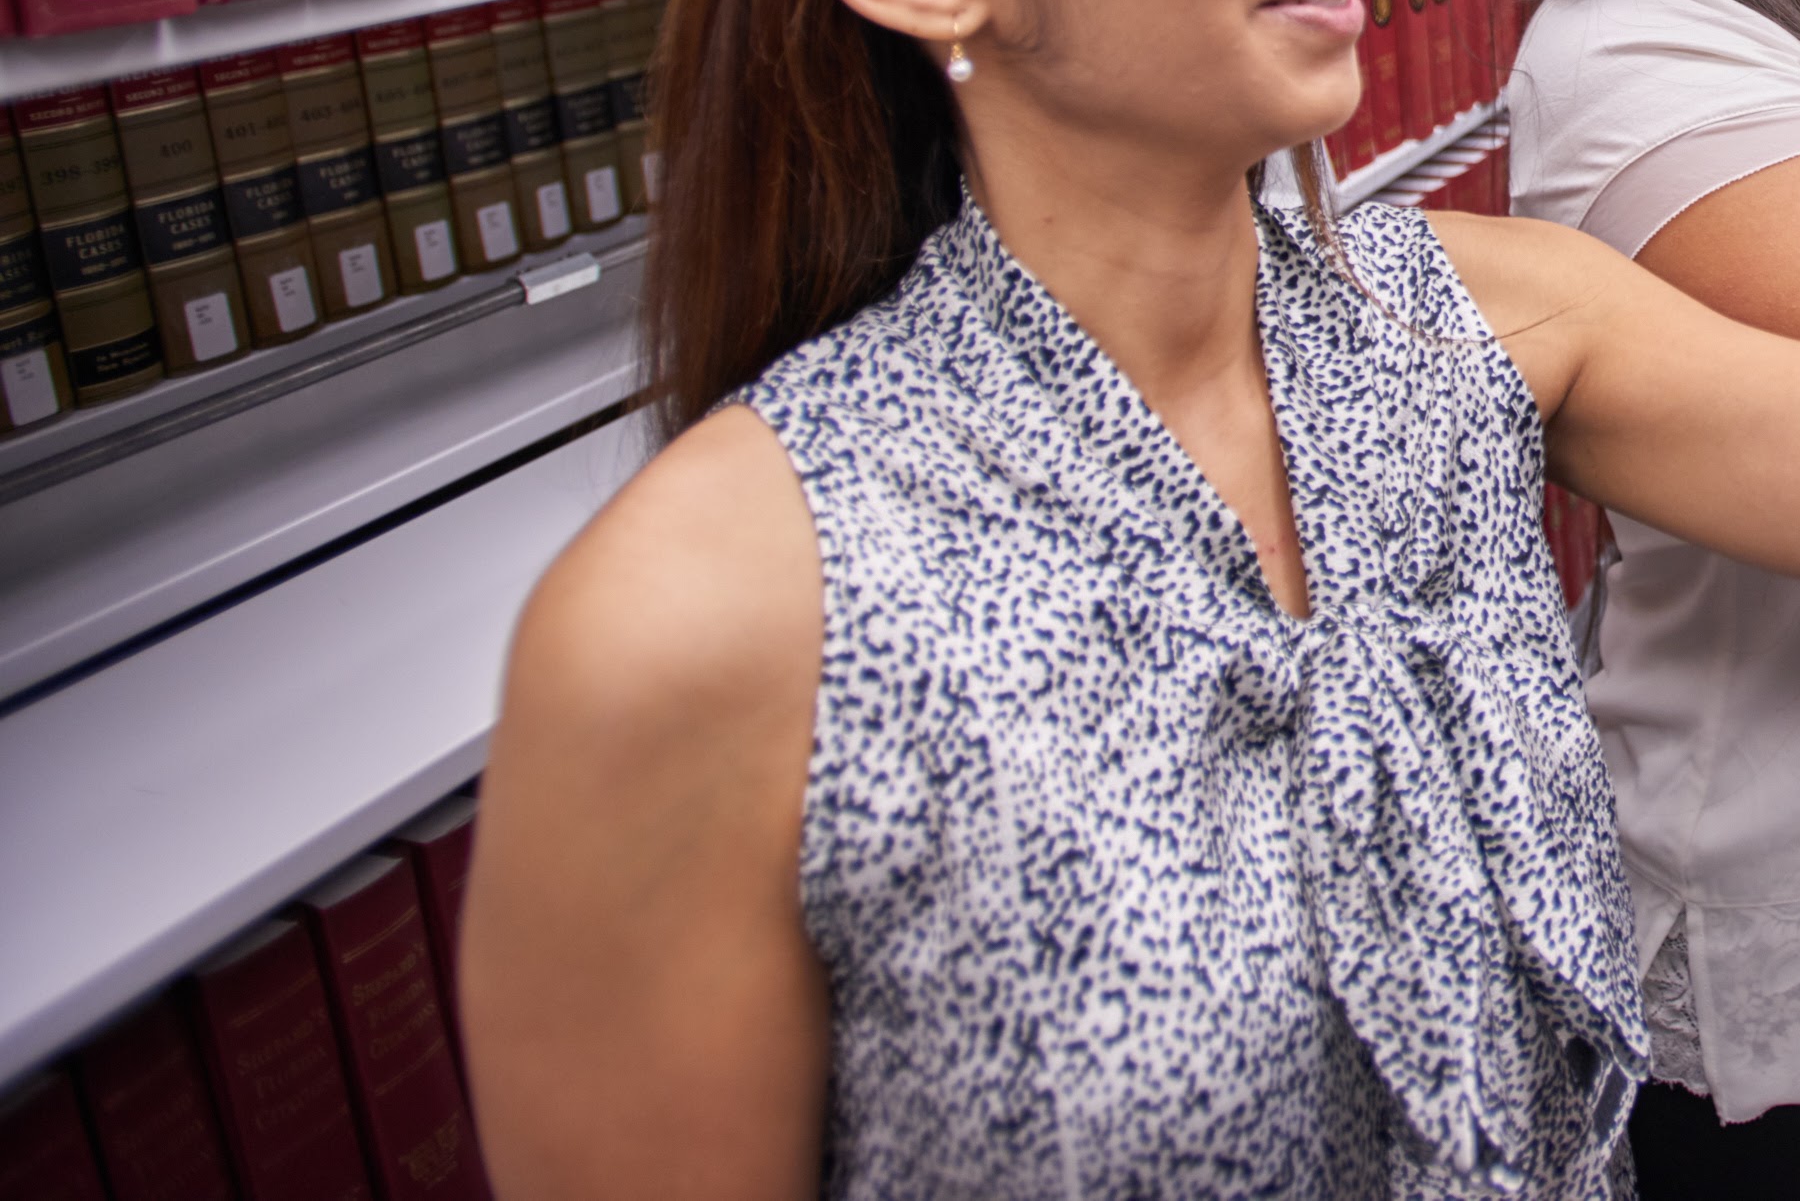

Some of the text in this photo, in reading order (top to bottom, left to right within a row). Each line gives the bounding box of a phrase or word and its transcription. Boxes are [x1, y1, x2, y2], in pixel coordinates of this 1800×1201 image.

[158, 201, 215, 225] FLORIDA
[66, 223, 126, 248] FLORIDA
[170, 215, 212, 235] CASES
[78, 239, 124, 260] CASES
